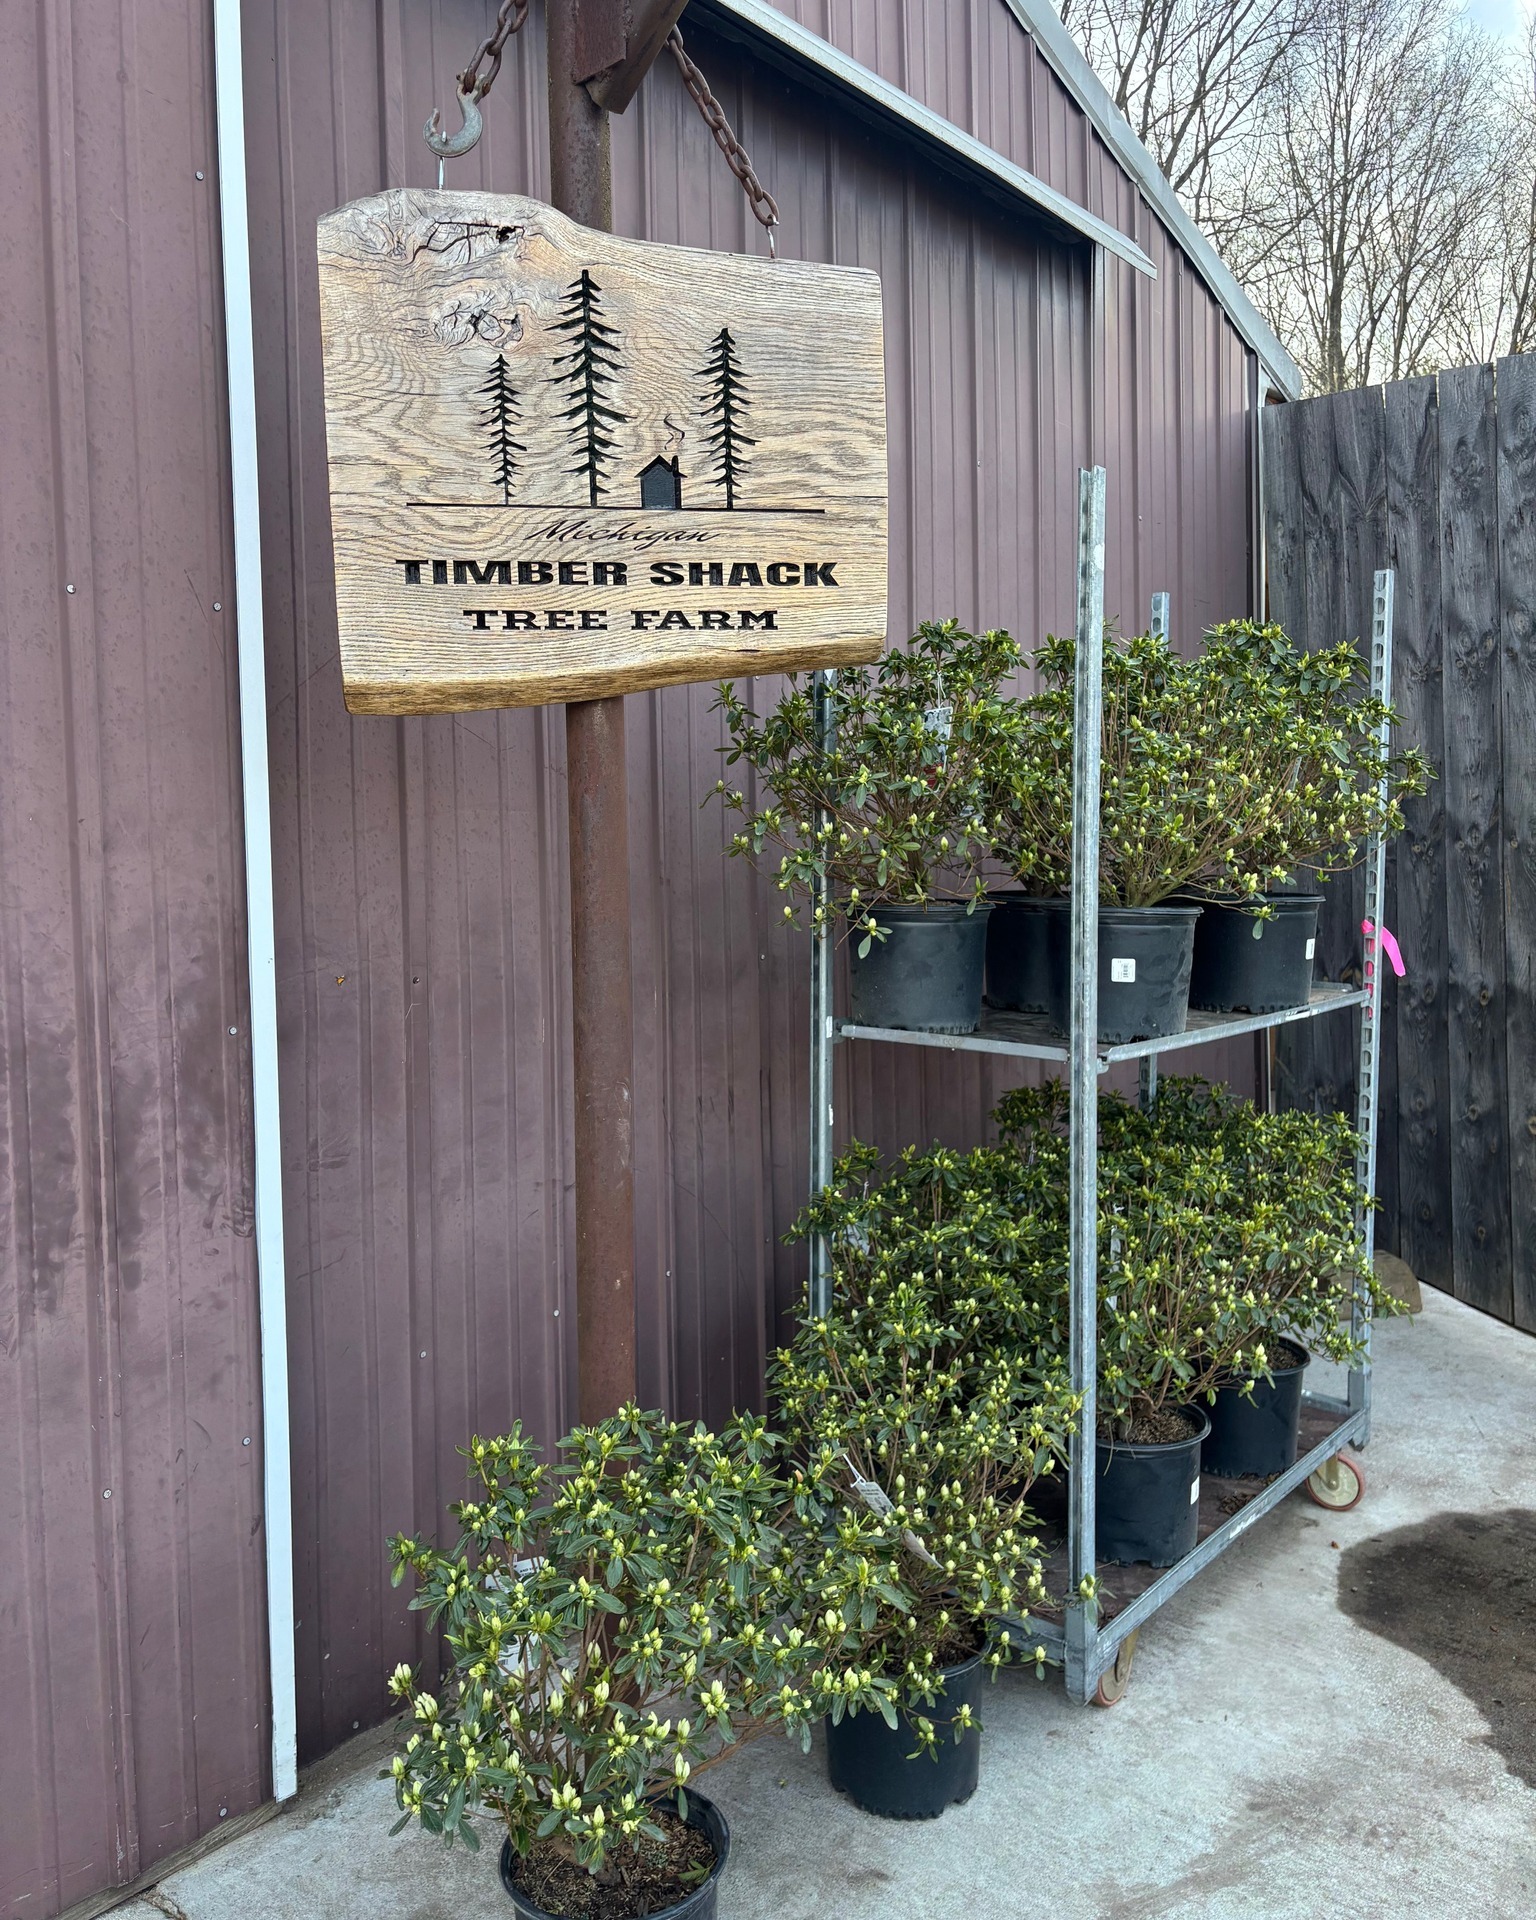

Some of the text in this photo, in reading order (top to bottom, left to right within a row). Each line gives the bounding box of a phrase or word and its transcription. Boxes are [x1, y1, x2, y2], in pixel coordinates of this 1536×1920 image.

[524, 520, 720, 550] Michigan
[395, 559, 839, 587] TIMBER SHACK
[462, 609, 778, 631] TREE FARM
